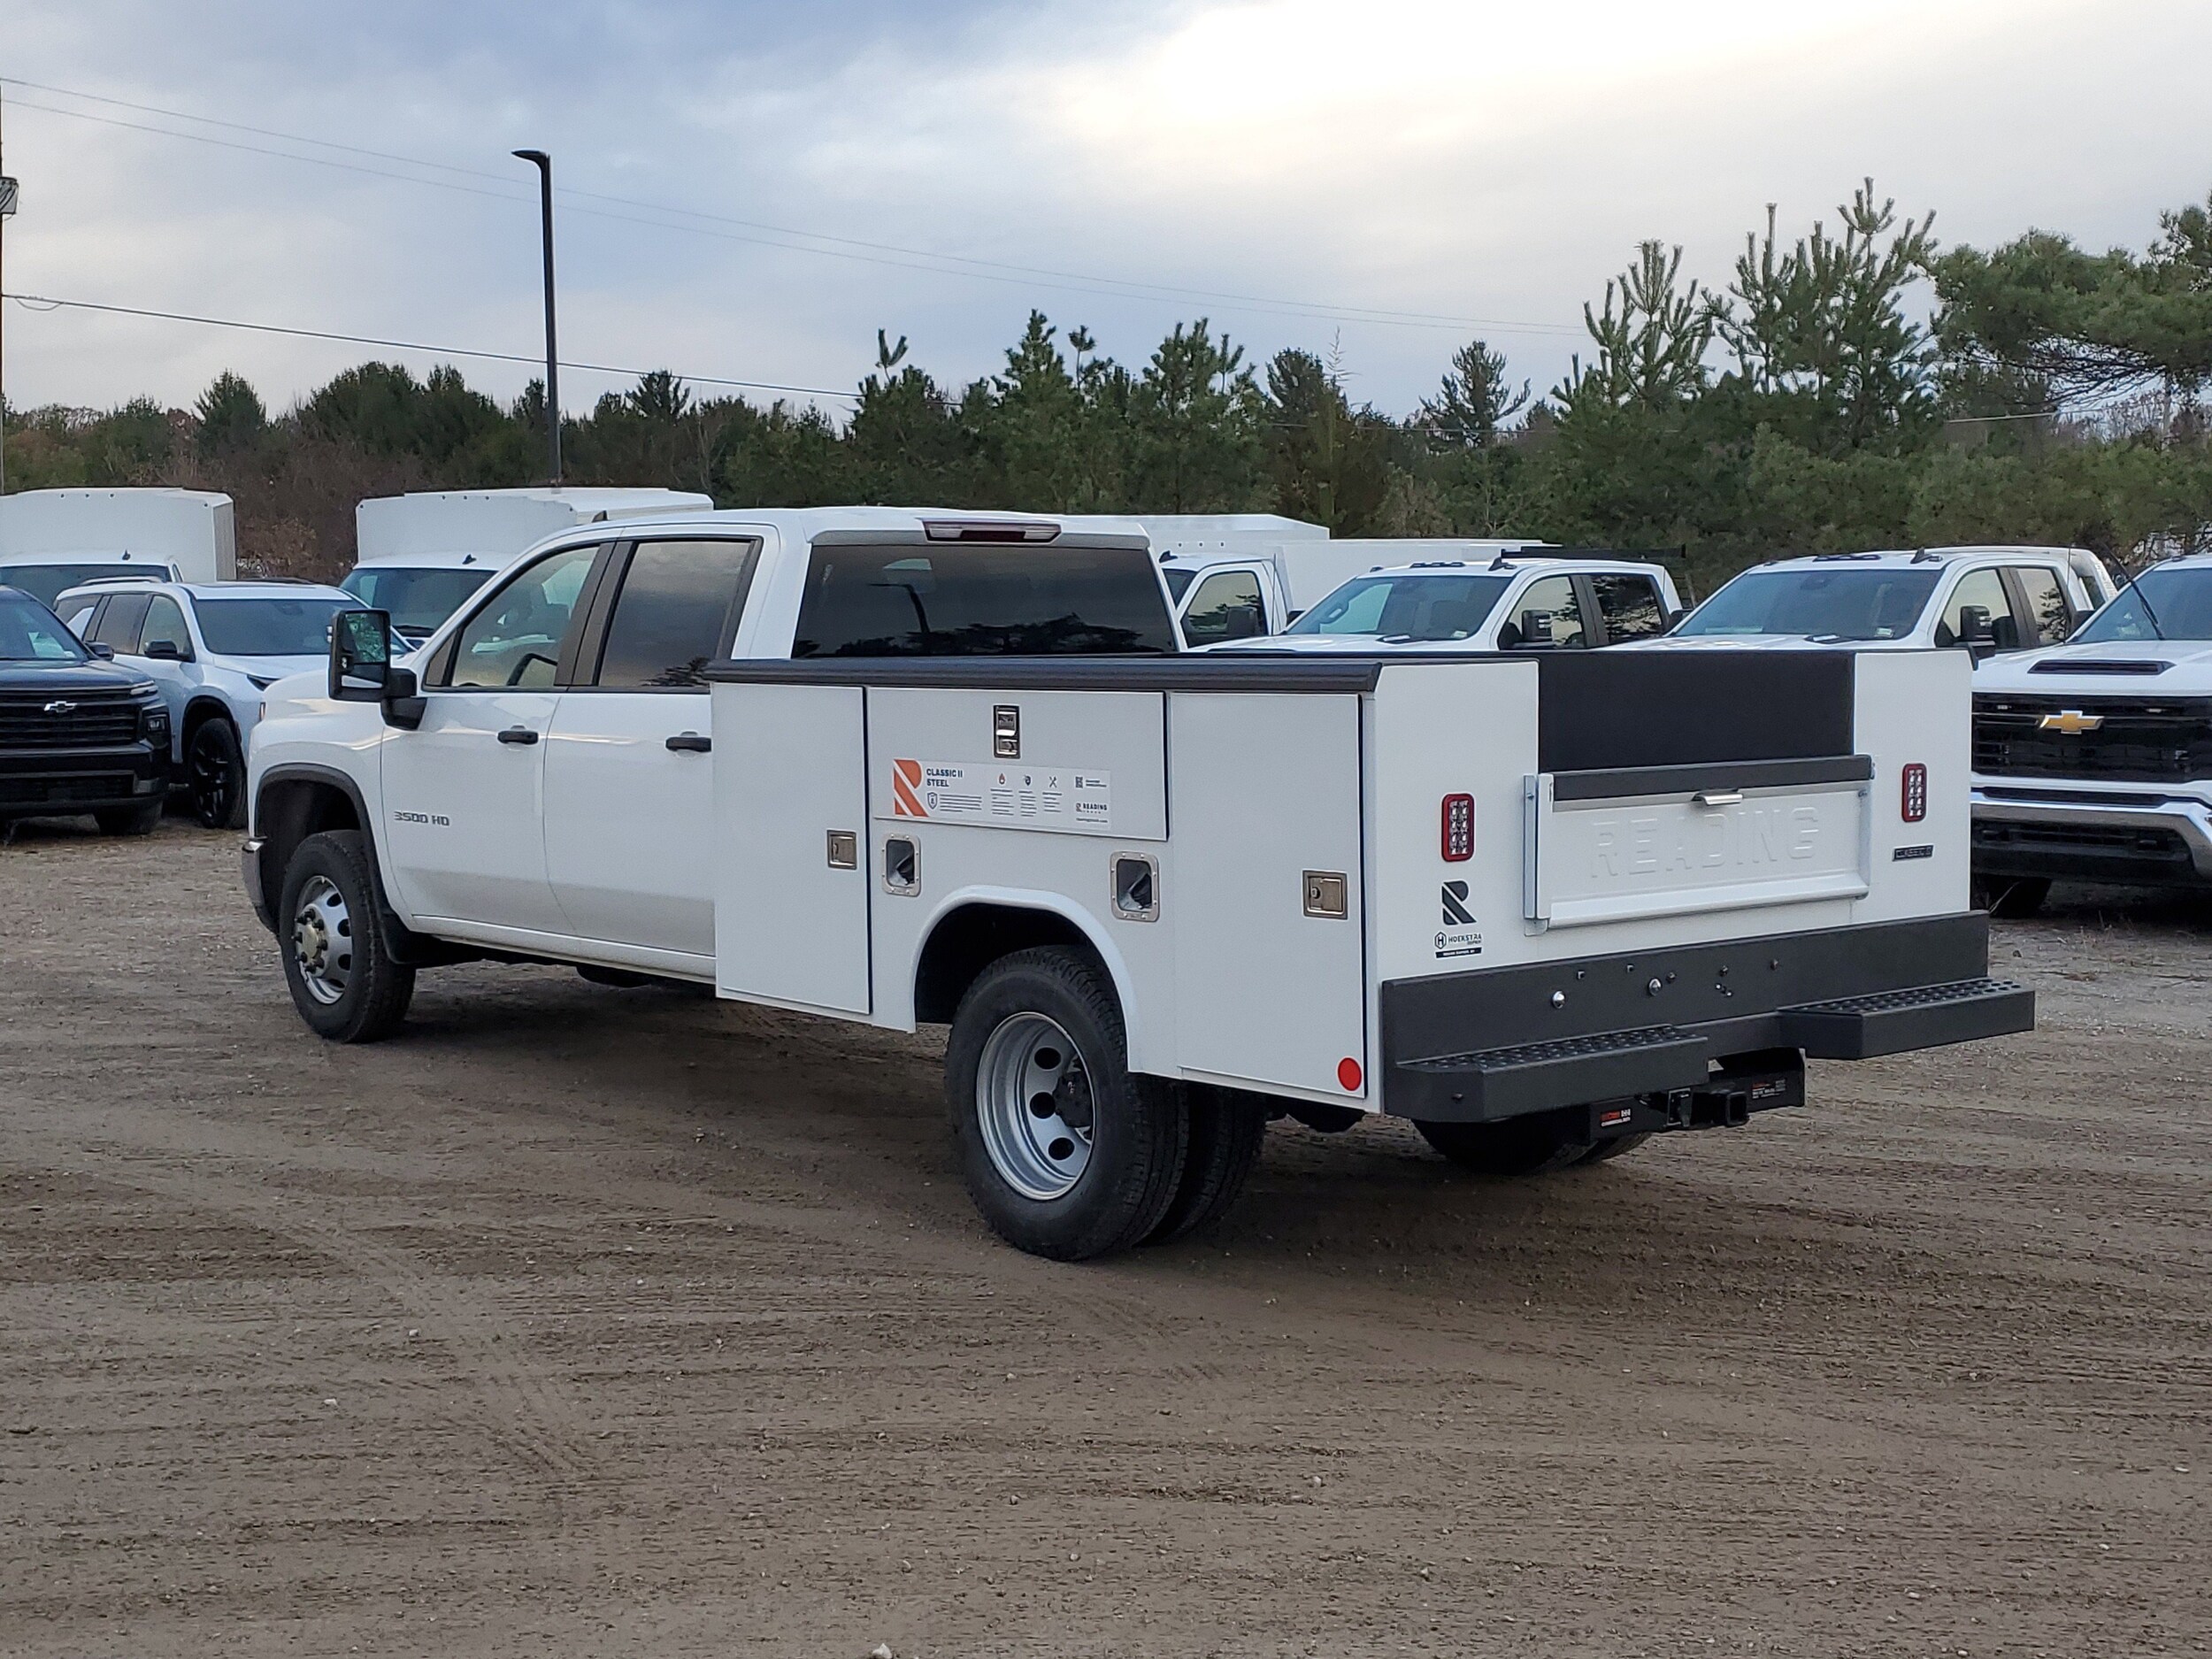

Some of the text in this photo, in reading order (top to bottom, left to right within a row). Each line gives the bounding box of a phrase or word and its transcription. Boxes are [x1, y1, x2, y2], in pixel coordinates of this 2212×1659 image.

[926, 768, 957, 778] CLASSIC
[926, 779, 949, 787] STEEL
[1082, 803, 1108, 811] READING
[394, 811, 450, 826] 3500 HD
[1592, 807, 1819, 878] READING
